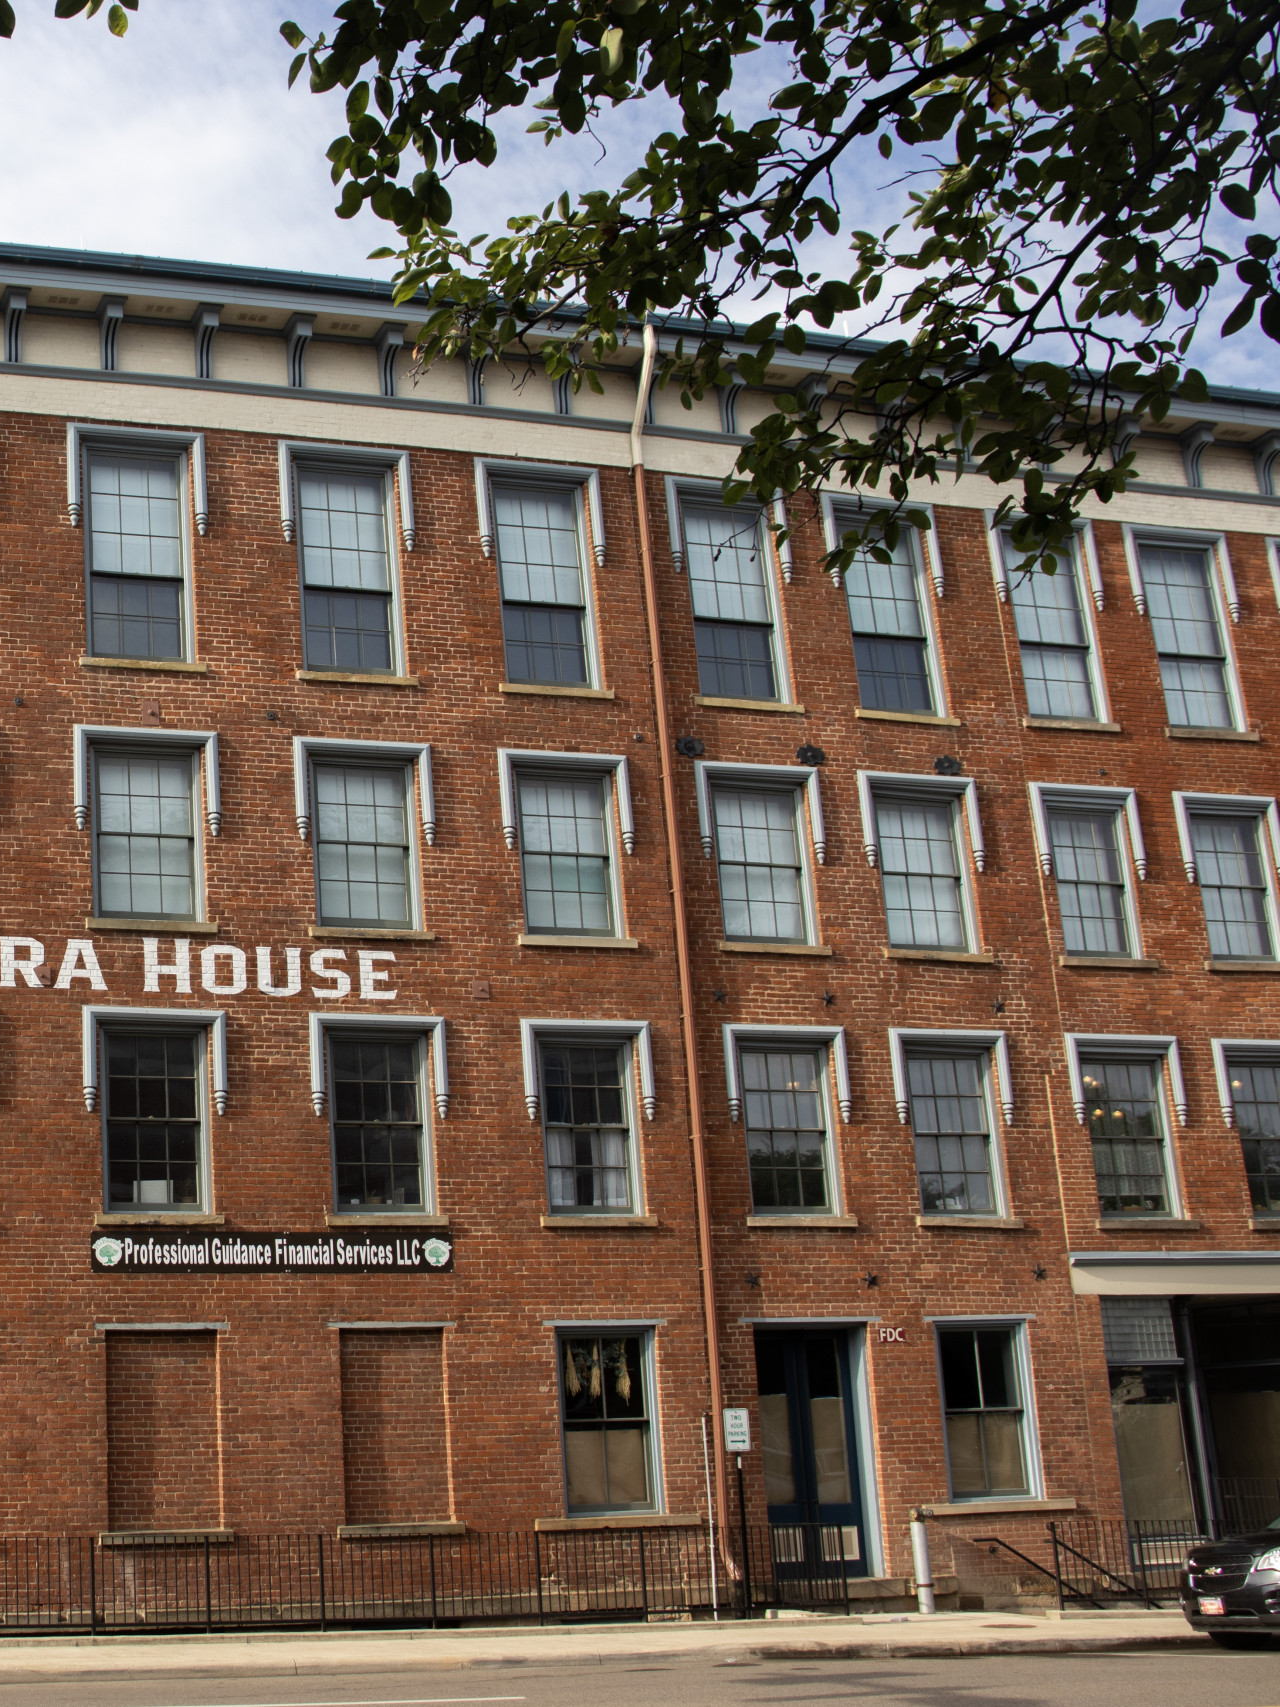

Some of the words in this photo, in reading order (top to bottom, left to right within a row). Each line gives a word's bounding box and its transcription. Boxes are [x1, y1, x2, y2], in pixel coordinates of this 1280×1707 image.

[142, 937, 397, 1000] HOUSE
[124, 1237, 210, 1265] Professional
[212, 1238, 272, 1265] Guidance
[274, 1238, 335, 1265] Financial
[336, 1238, 393, 1265] Services
[396, 1238, 420, 1266] LLC
[879, 1327, 904, 1342] FDC
